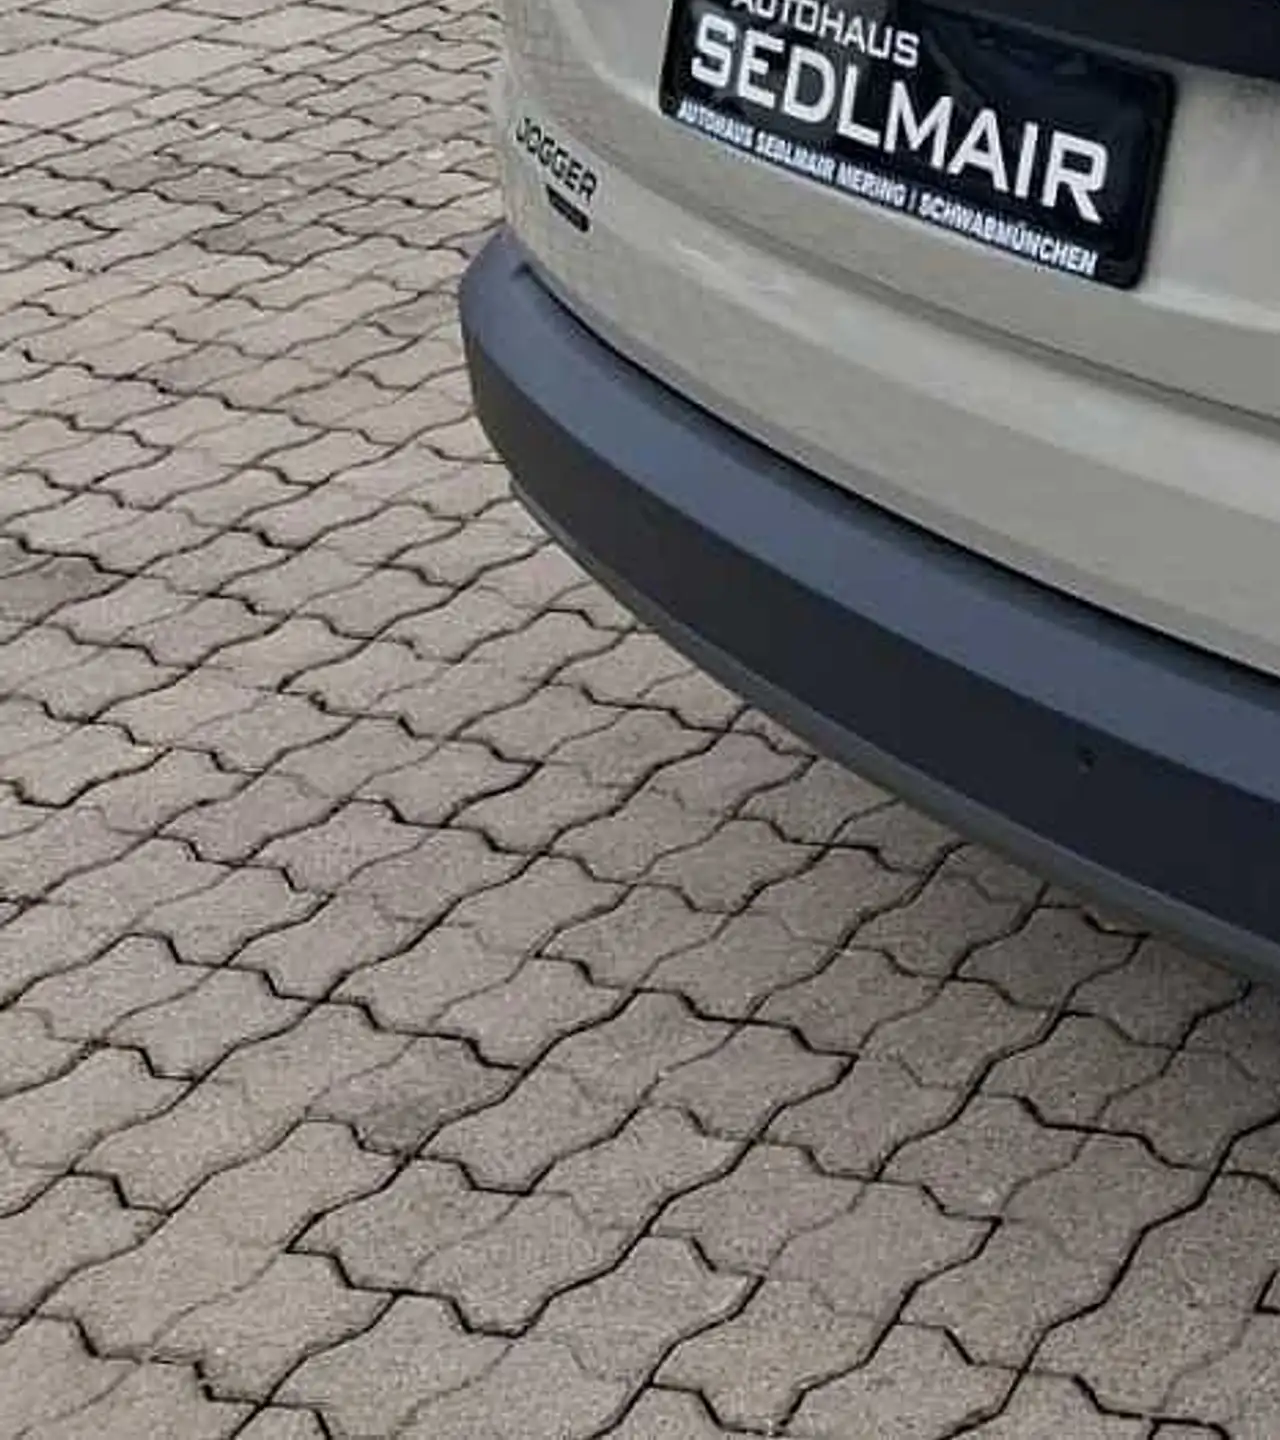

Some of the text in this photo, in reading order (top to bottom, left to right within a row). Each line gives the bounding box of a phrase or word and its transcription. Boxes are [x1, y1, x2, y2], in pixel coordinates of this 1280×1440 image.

[515, 116, 598, 202] JOGGER
[677, 96, 755, 149] AUTOHAUS
[754, 130, 837, 182] SEDLMAIR
[836, 161, 907, 207] MERING
[918, 192, 1099, 276] SCHWABMÜNCHEN
[690, 13, 1108, 224] SEDLMAIR
